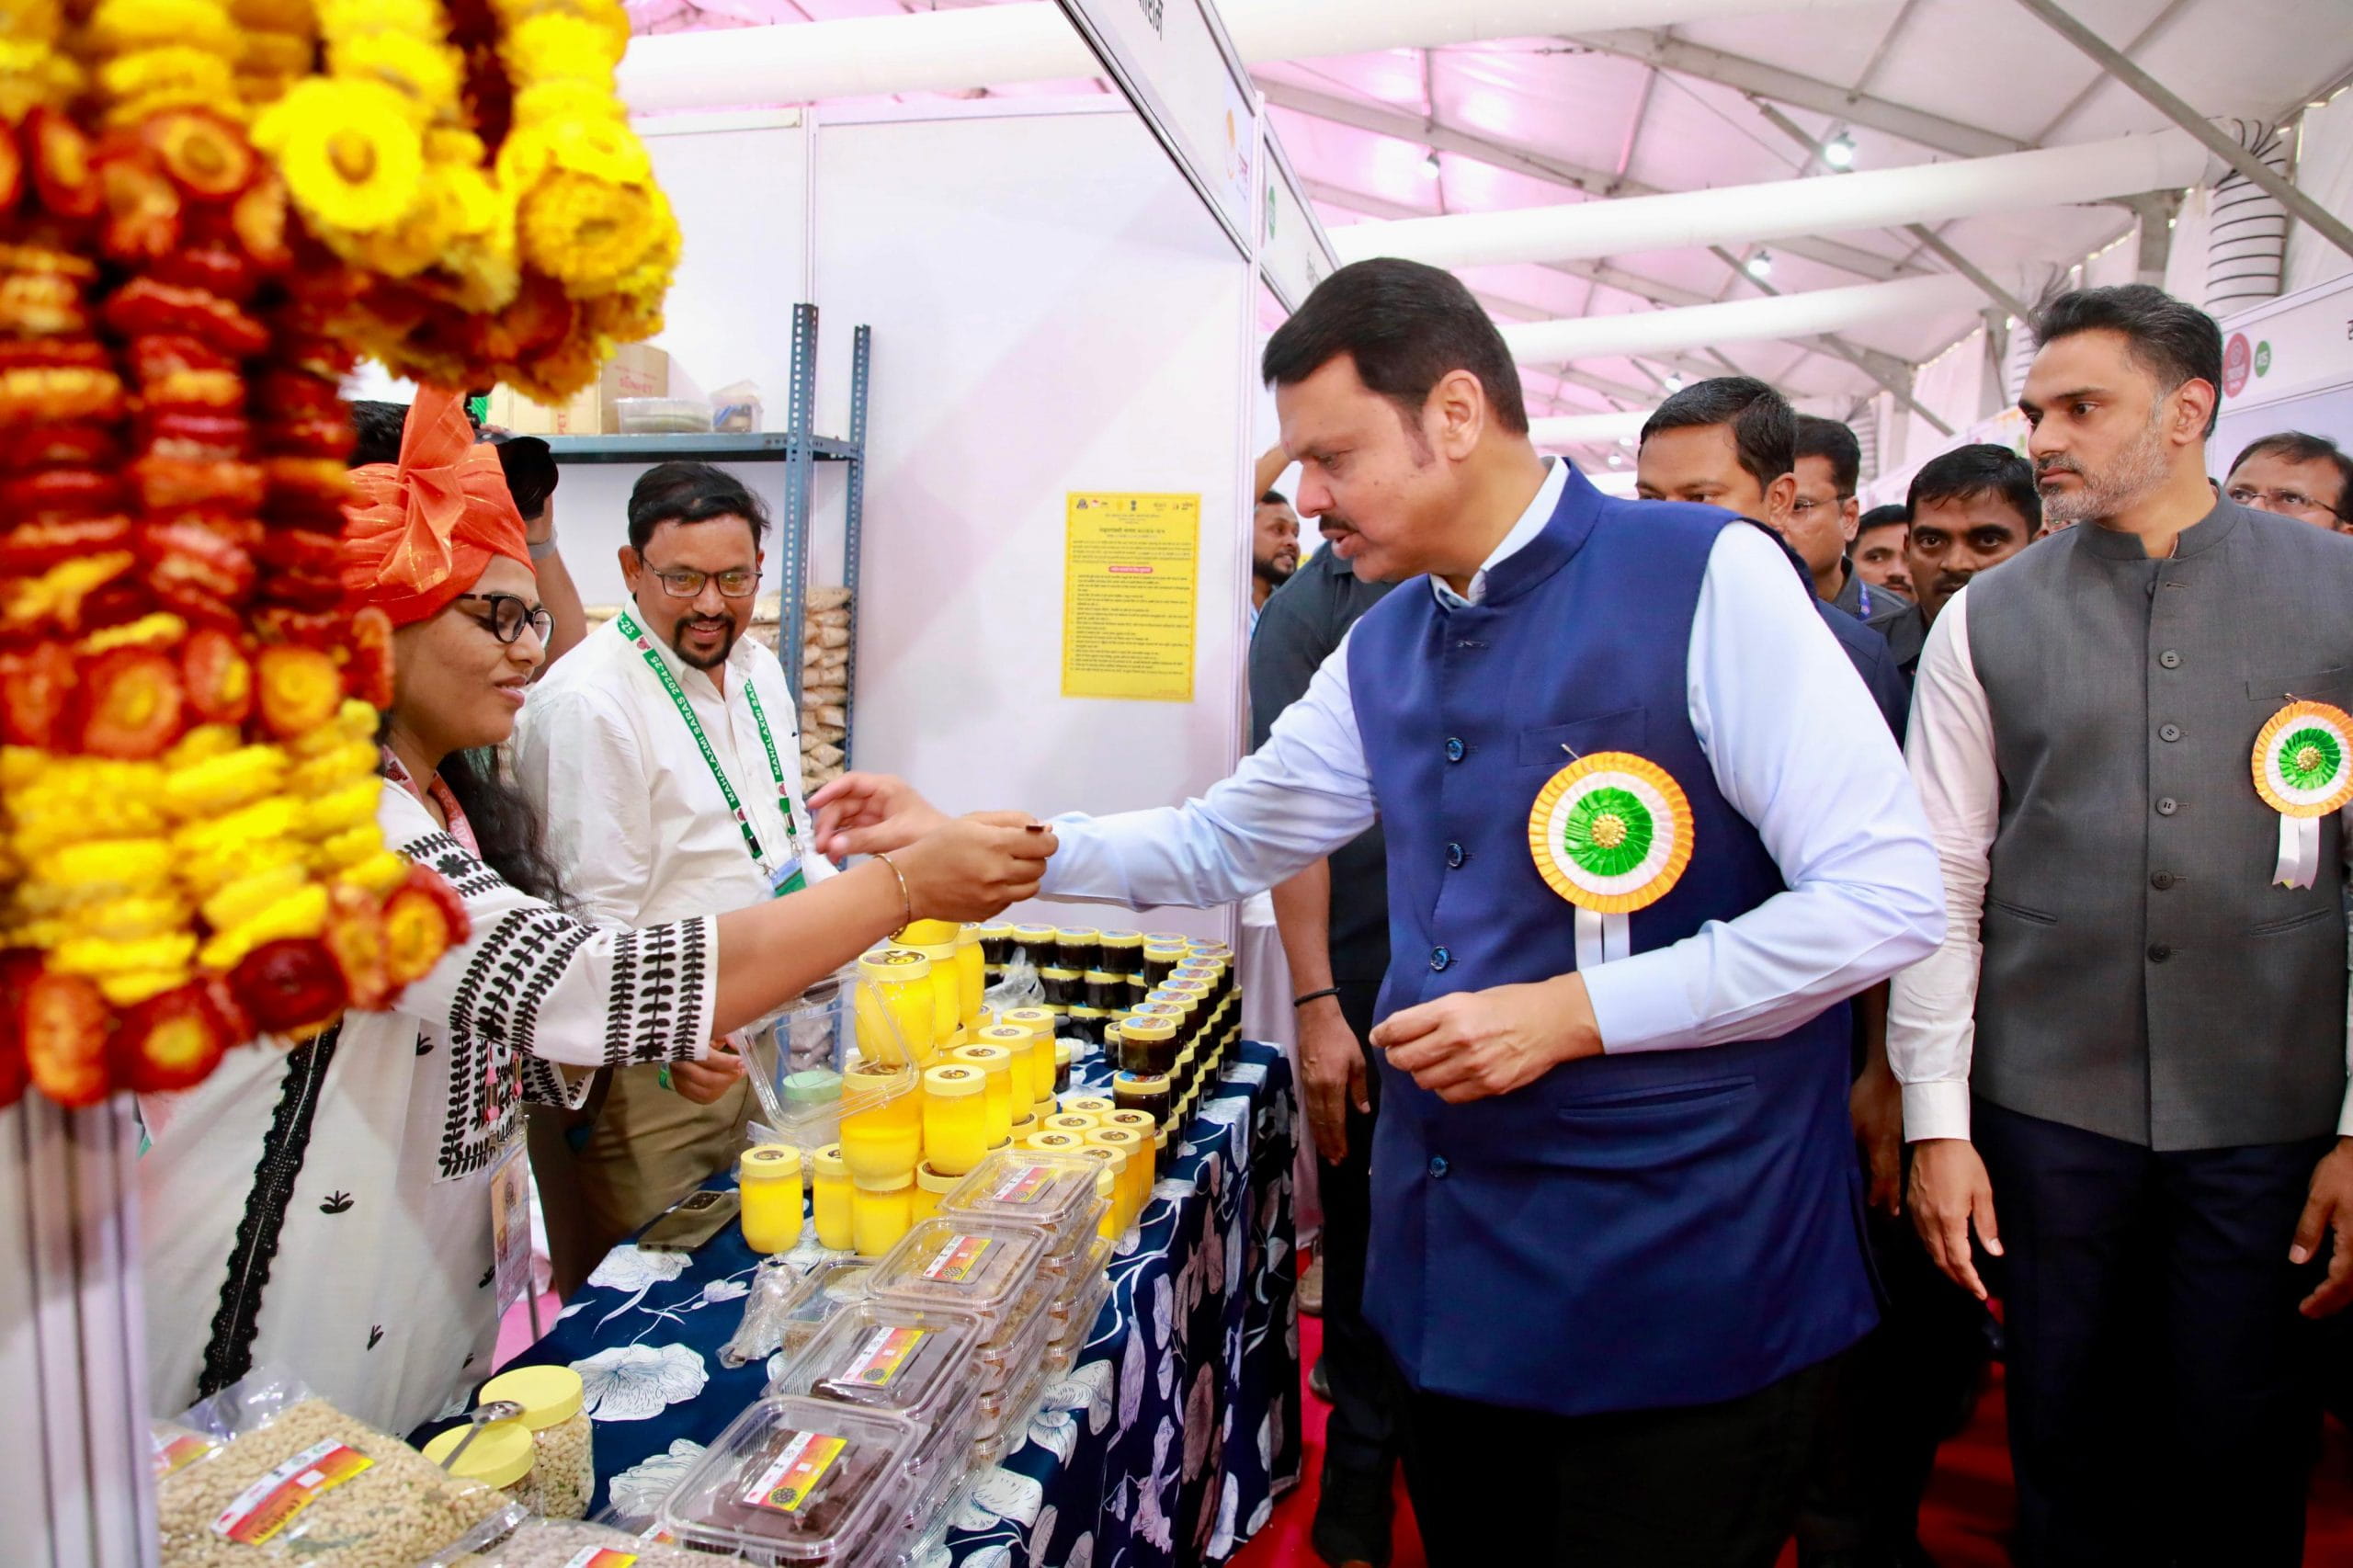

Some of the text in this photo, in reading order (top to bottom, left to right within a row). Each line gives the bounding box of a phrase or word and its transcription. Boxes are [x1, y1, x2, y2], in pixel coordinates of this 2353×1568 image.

[650, 656, 736, 802] MAHALAXMI SARAS 2024-25
[755, 709, 780, 776] MAHALAXMI
